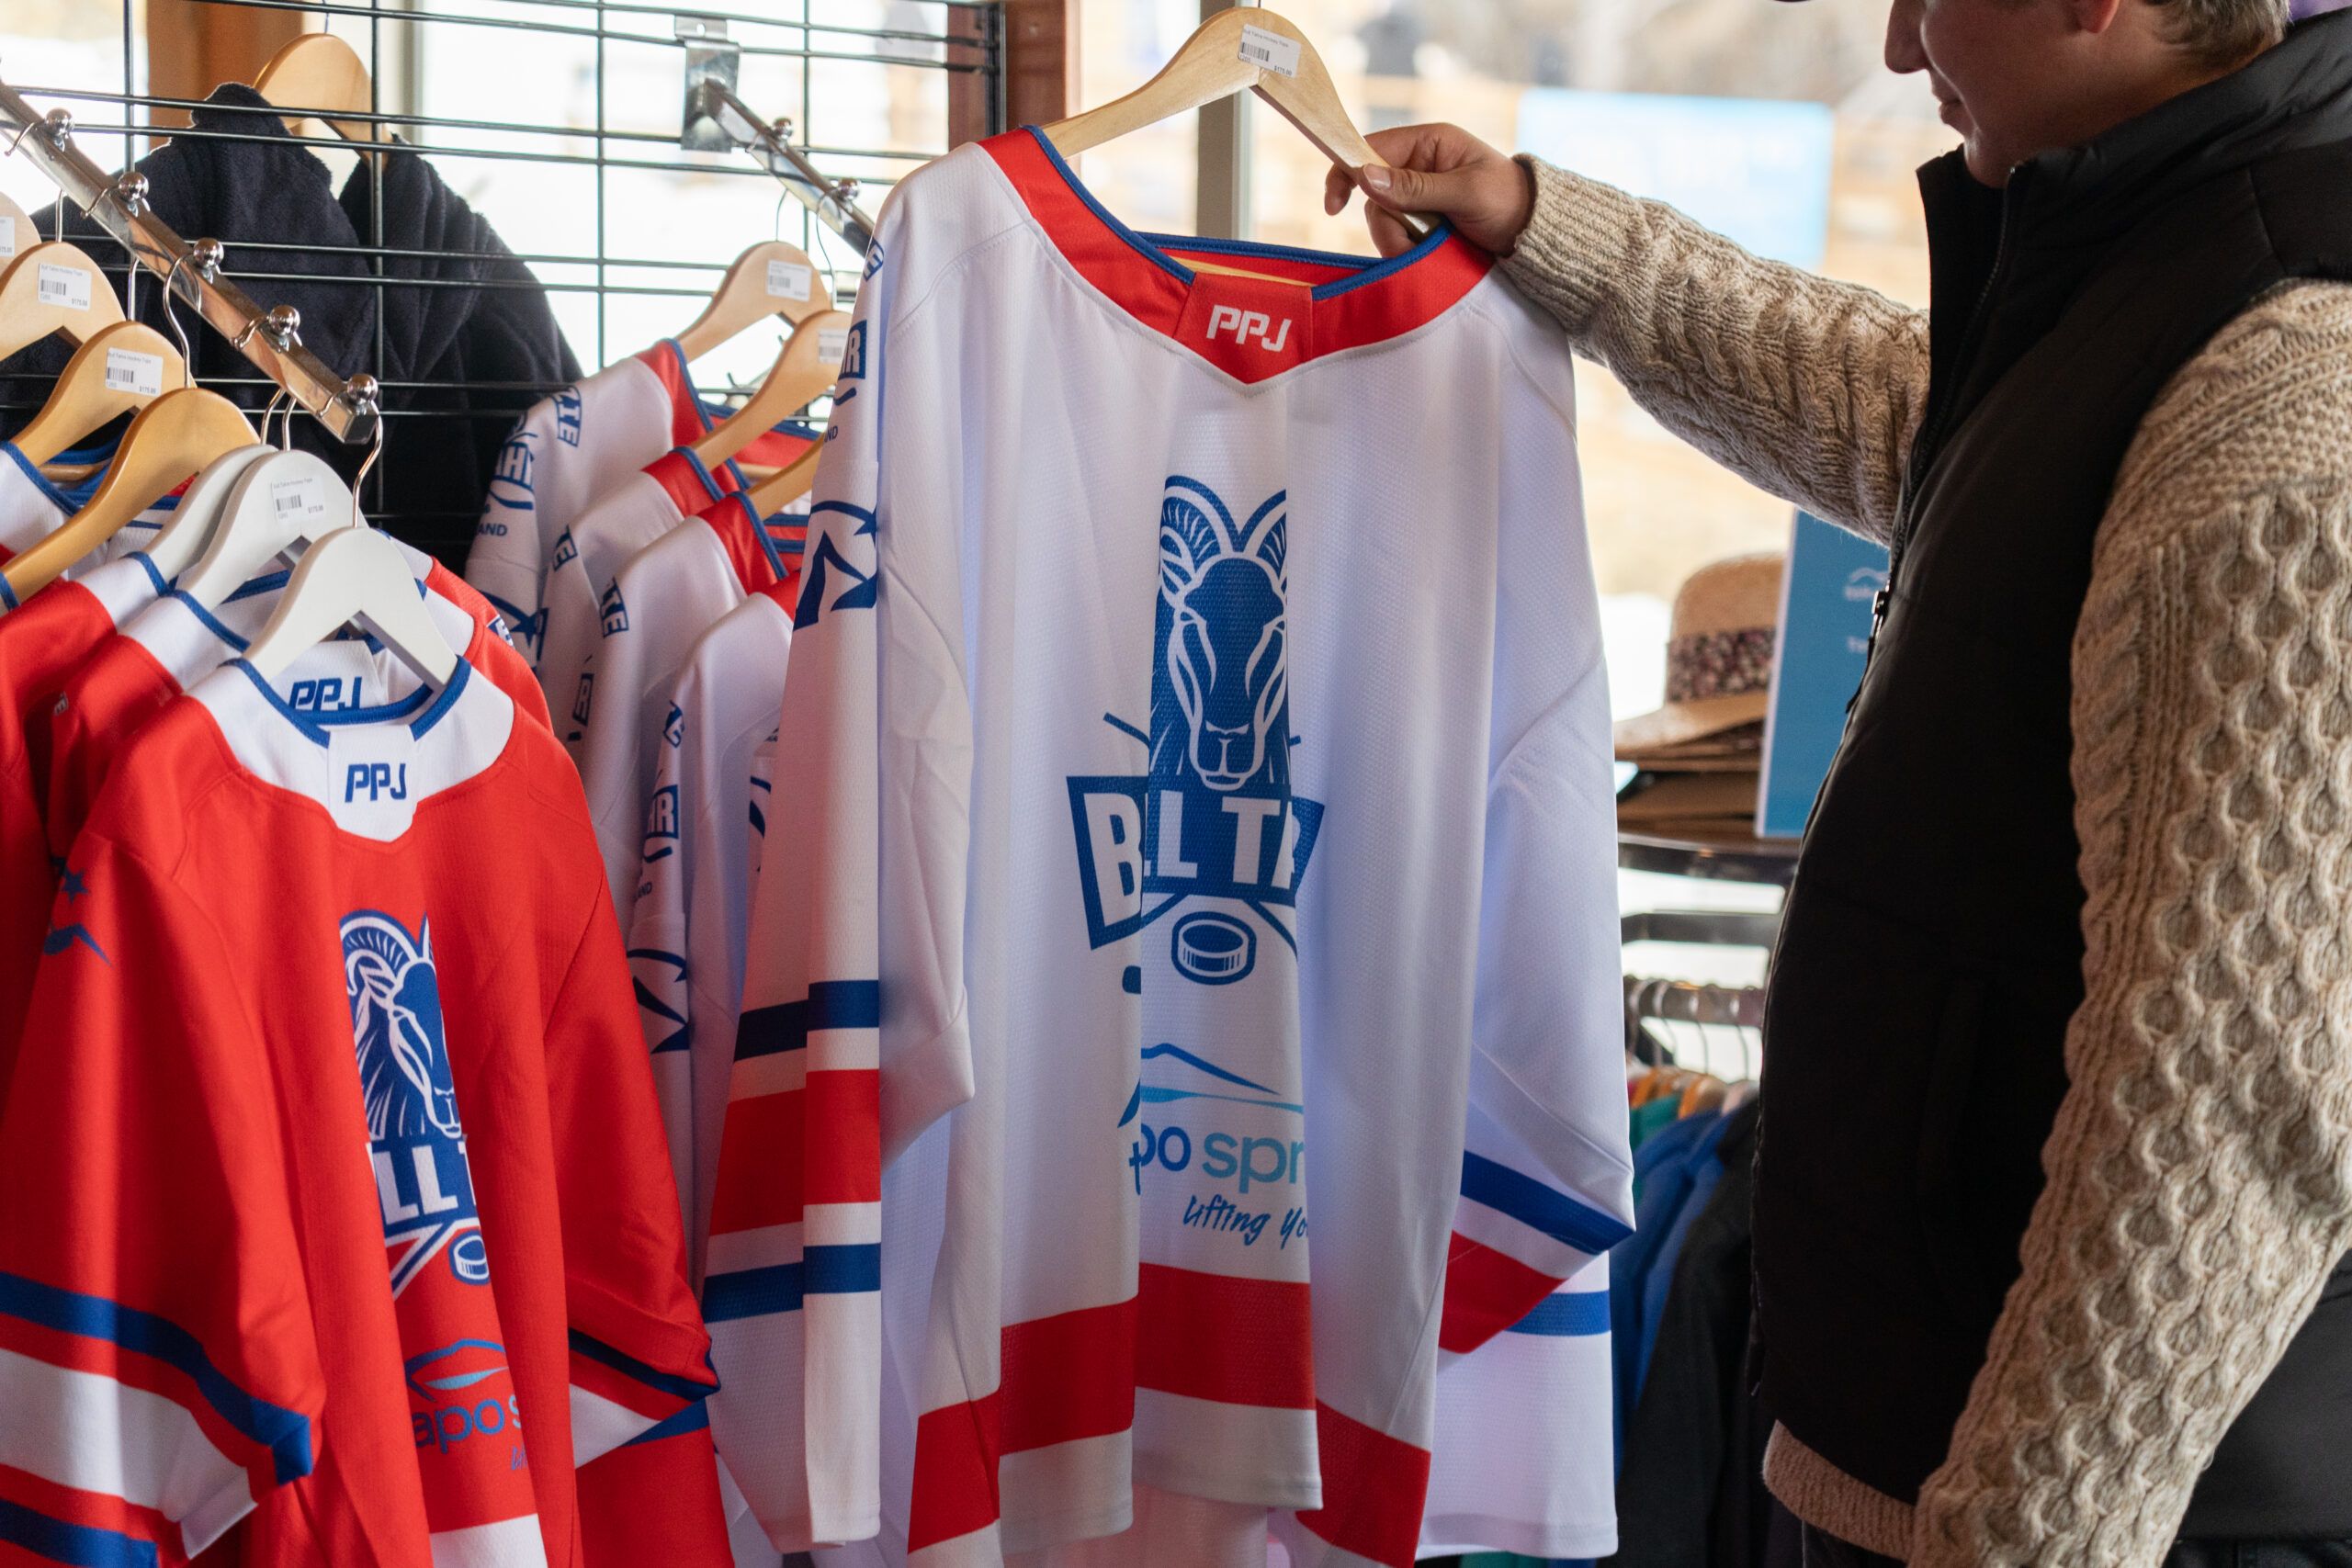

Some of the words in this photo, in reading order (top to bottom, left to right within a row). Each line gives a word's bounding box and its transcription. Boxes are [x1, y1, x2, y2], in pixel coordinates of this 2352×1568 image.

[1206, 304, 1292, 353] PPJ
[345, 762, 407, 803] PPJ
[1202, 1132, 1305, 1195] spr
